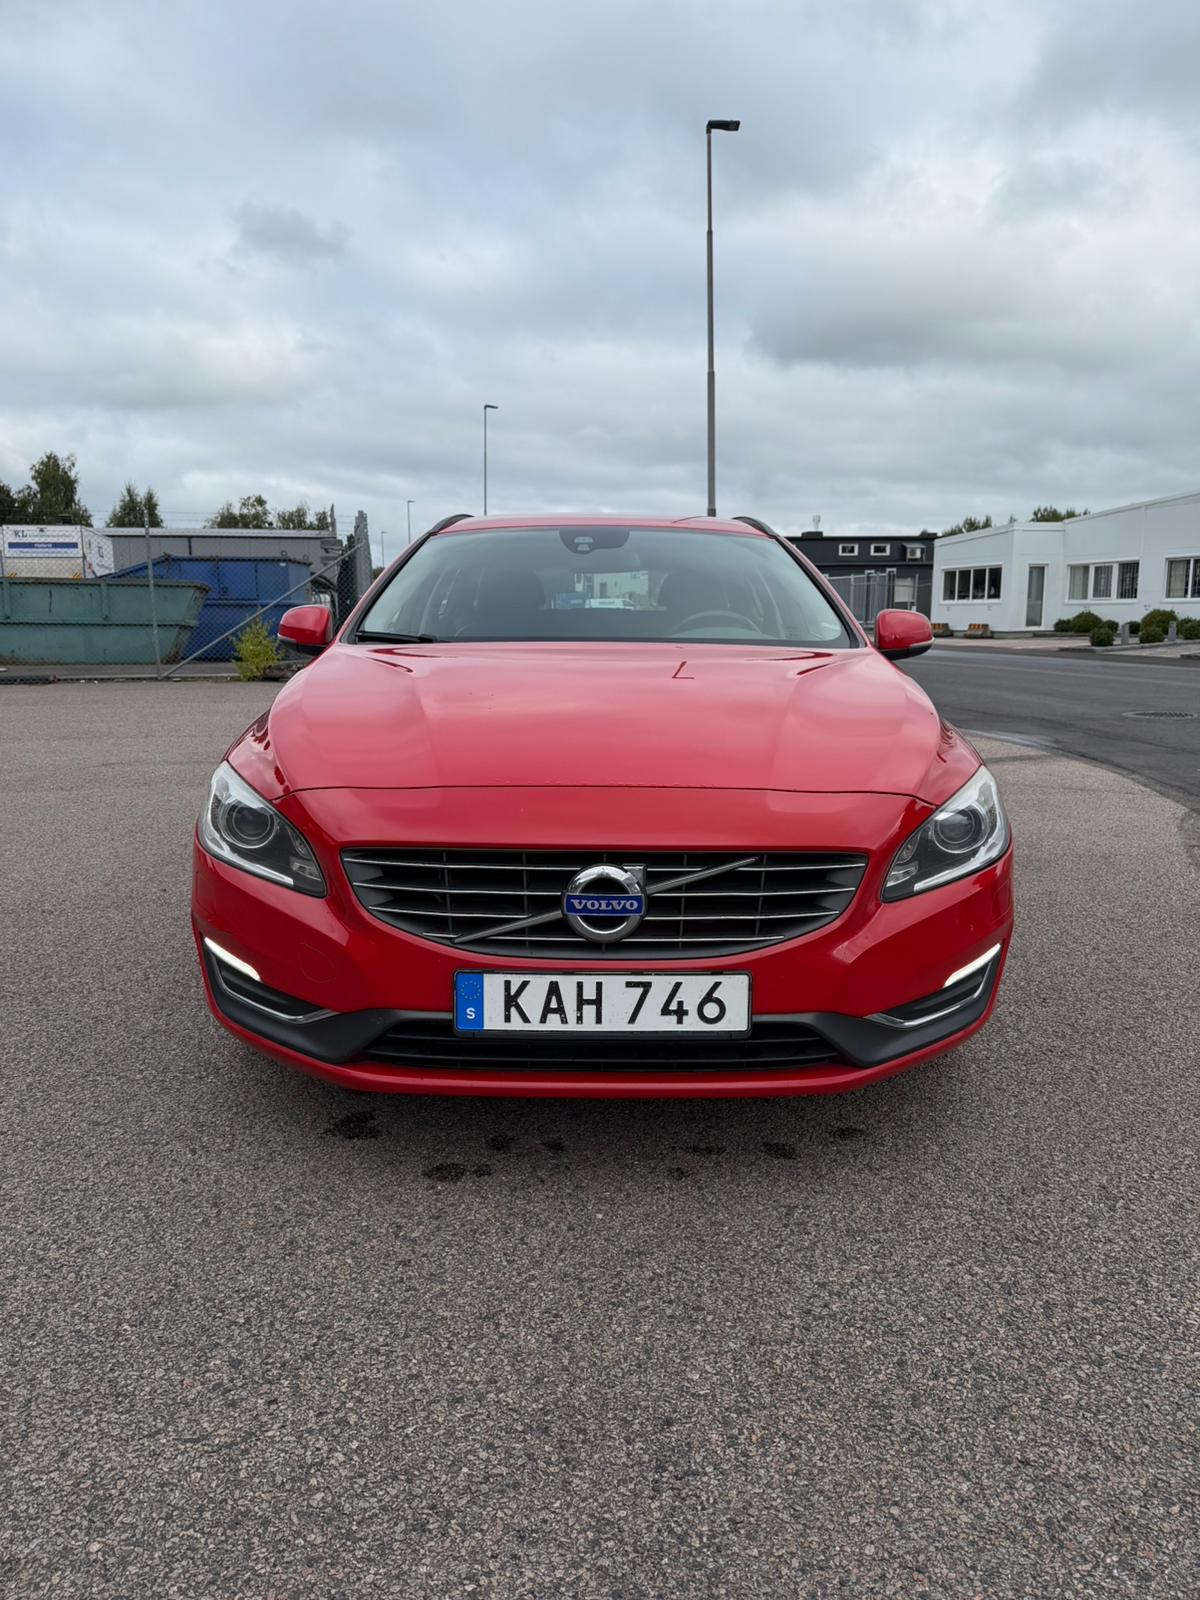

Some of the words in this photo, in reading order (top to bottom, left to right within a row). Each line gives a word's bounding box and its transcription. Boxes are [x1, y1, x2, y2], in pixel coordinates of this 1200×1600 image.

[570, 899, 639, 911] VOLVO
[503, 979, 604, 1025] KAH
[625, 980, 727, 1025] 746
[466, 1007, 476, 1020] S
